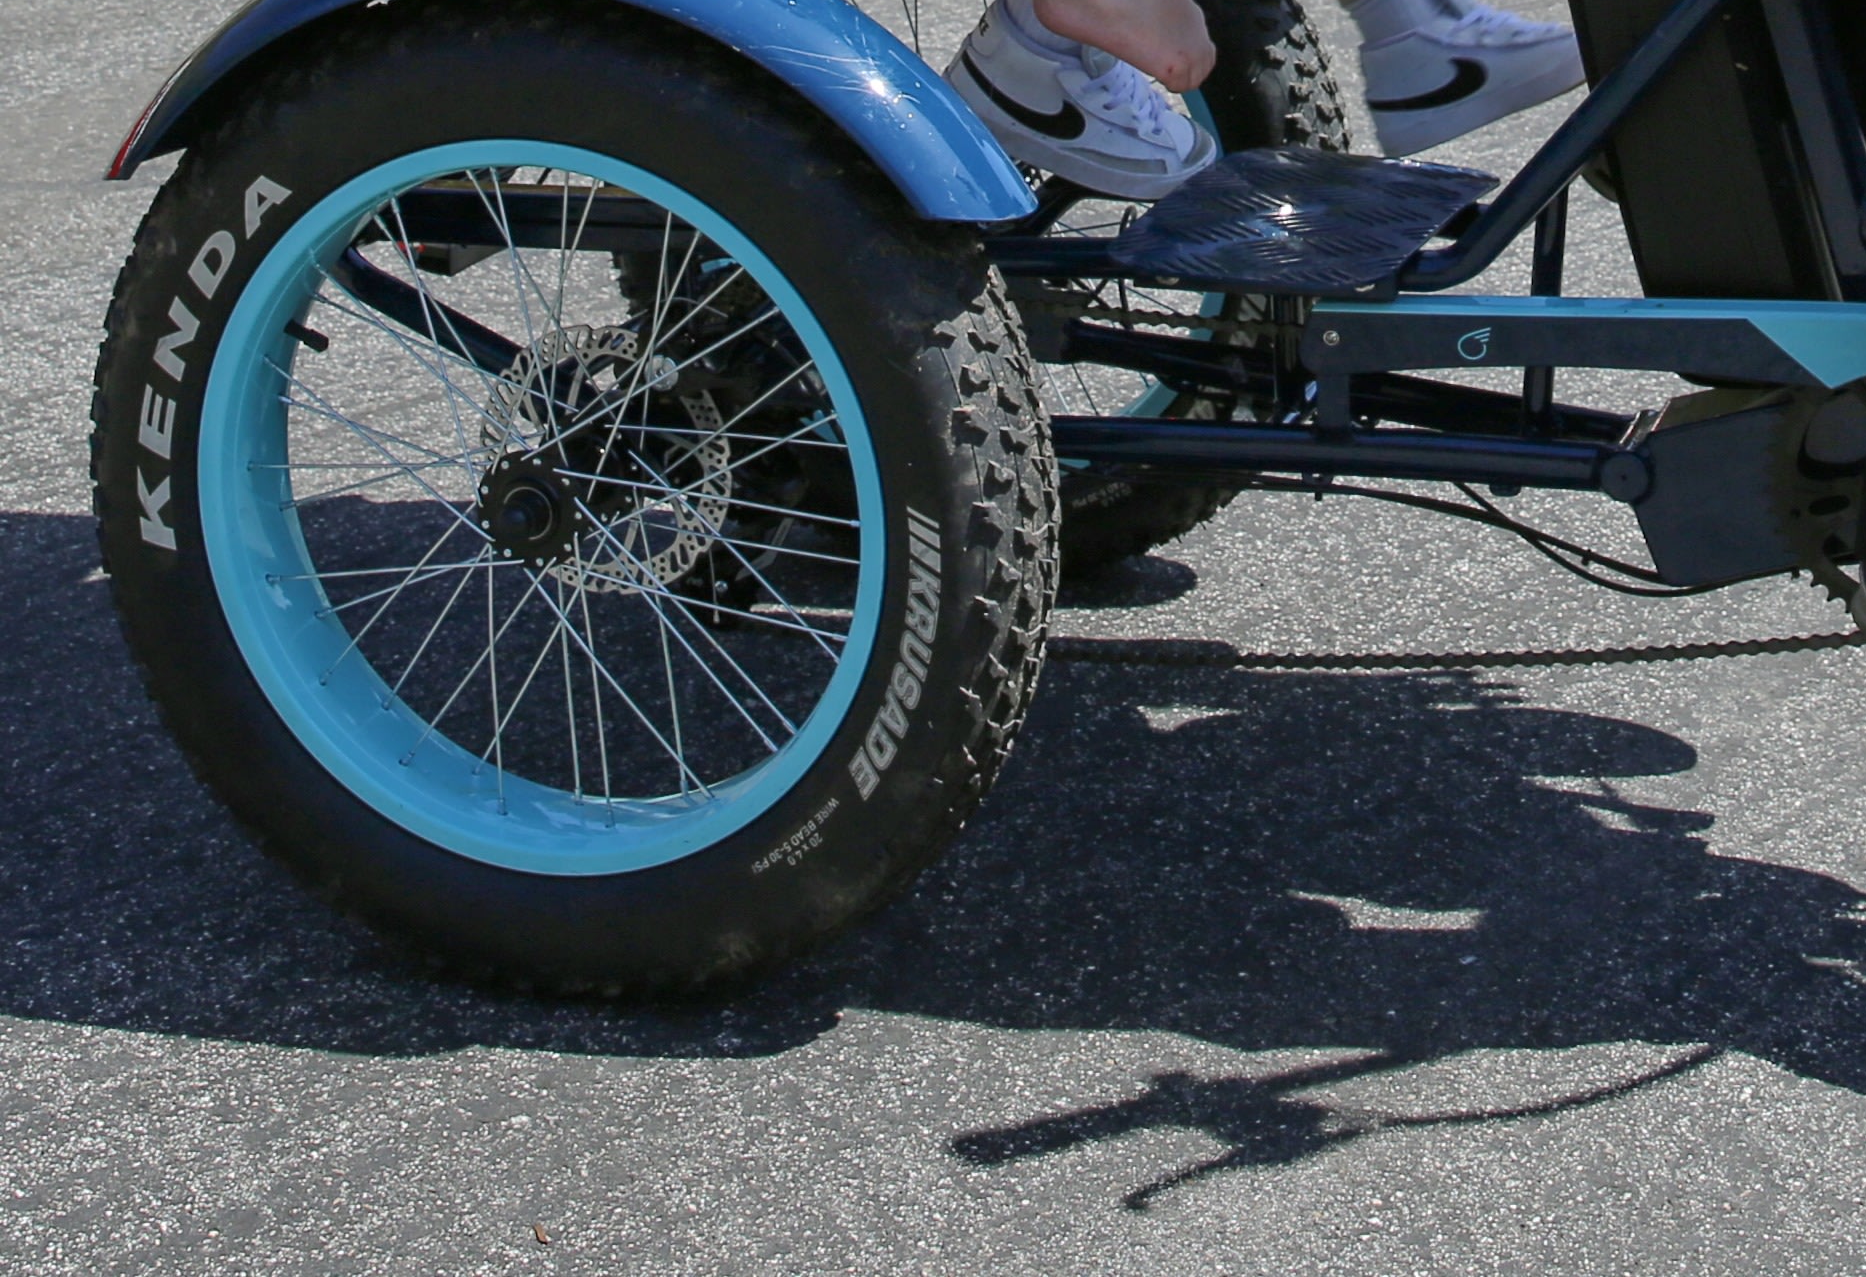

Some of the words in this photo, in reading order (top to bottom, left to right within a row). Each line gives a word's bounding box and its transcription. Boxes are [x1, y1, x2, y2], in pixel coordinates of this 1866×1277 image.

[137, 175, 292, 551] KENDA
[848, 558, 942, 802] KRUSADE
[814, 797, 840, 825] WIRE
[790, 820, 817, 846] BEAD
[808, 832, 823, 848] 20
[768, 841, 793, 863] 5-30
[751, 856, 771, 875] PSI
